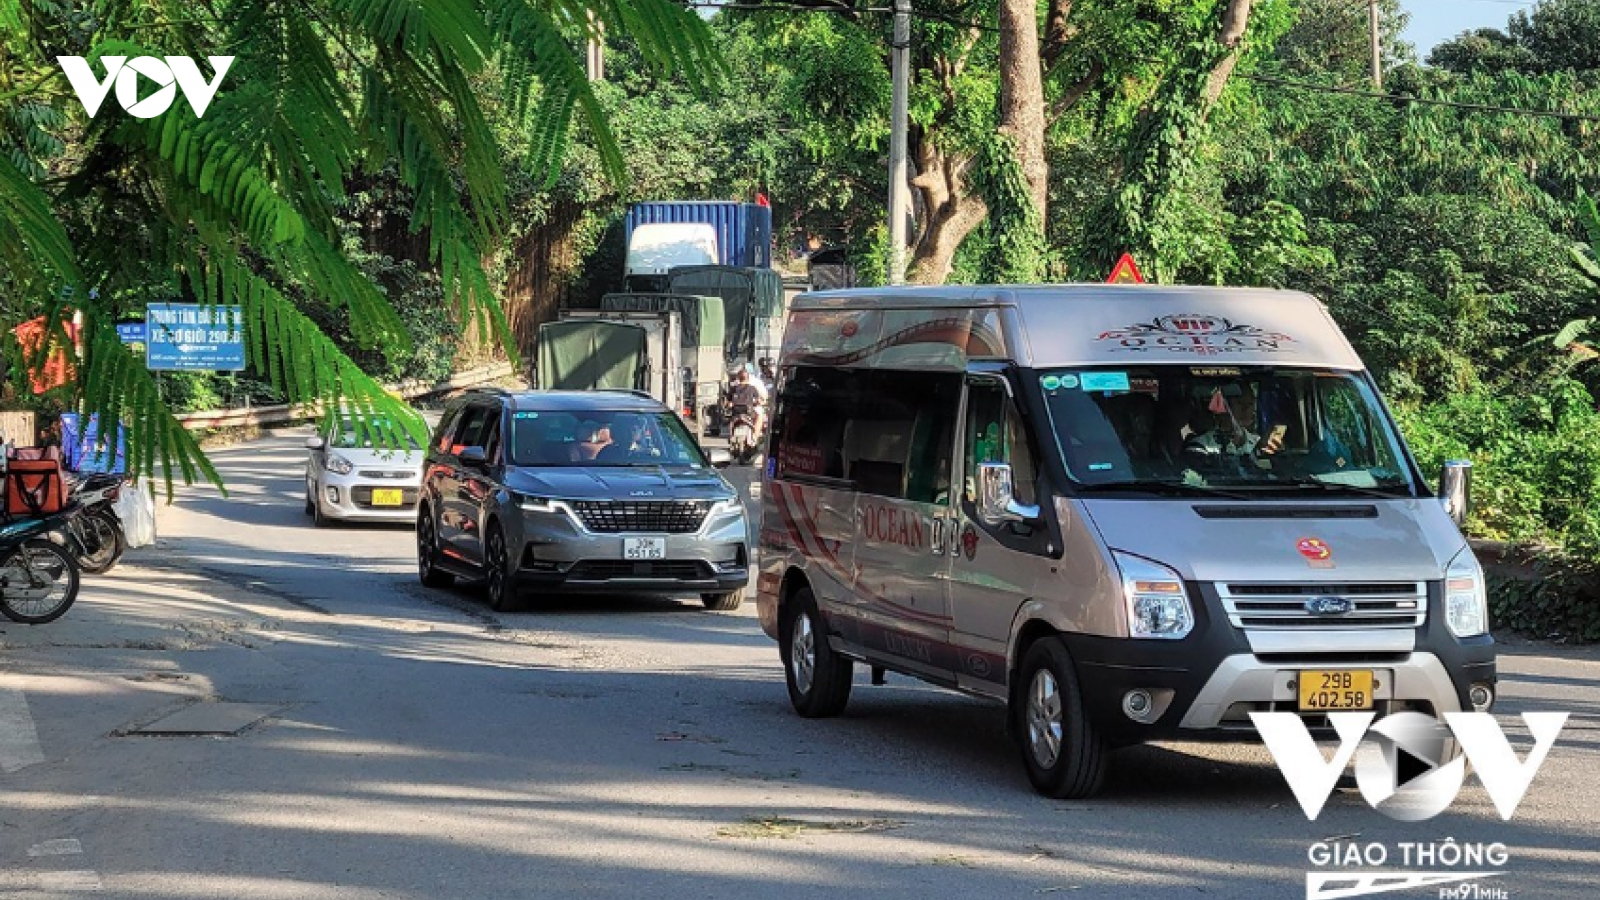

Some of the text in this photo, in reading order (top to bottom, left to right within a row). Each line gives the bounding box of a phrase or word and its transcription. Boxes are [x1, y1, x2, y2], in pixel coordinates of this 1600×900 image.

[1172, 319, 1215, 330] VIP
[1120, 336, 1280, 348] OCEAN
[864, 504, 922, 547] OCEAN
[1318, 600, 1346, 611] Ford
[1320, 672, 1352, 689] 29B
[1307, 691, 1365, 707] 402.58
